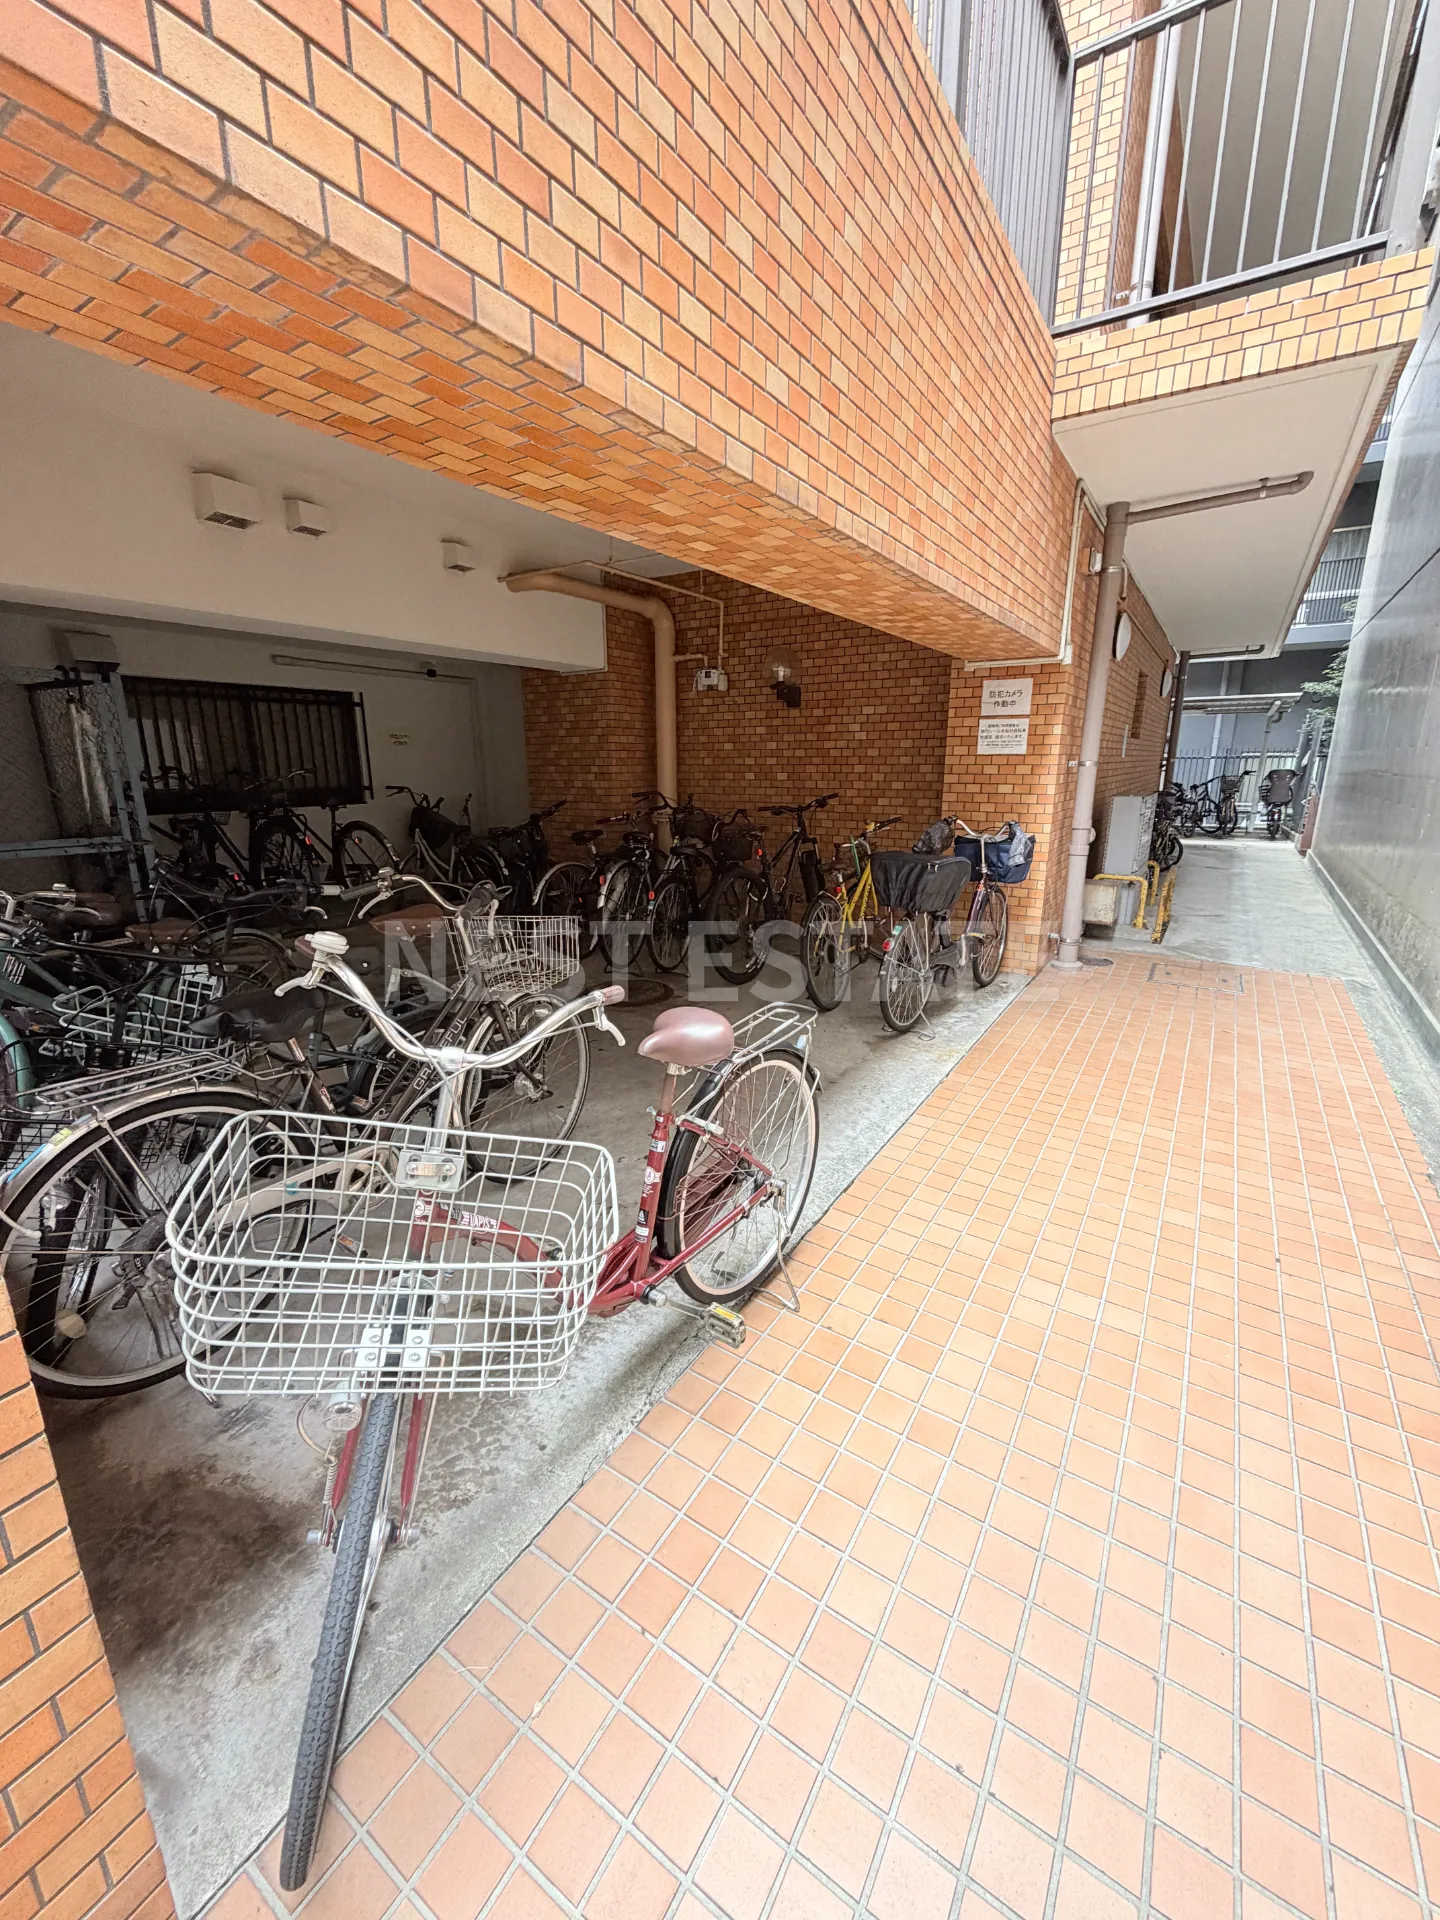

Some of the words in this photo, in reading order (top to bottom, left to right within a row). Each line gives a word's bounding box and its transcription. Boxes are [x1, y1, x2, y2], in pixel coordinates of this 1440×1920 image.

[989, 690, 1023, 698] 防犯カメラ
[993, 700, 1016, 708] 作動中
[413, 1017, 468, 1090] GREFUL
